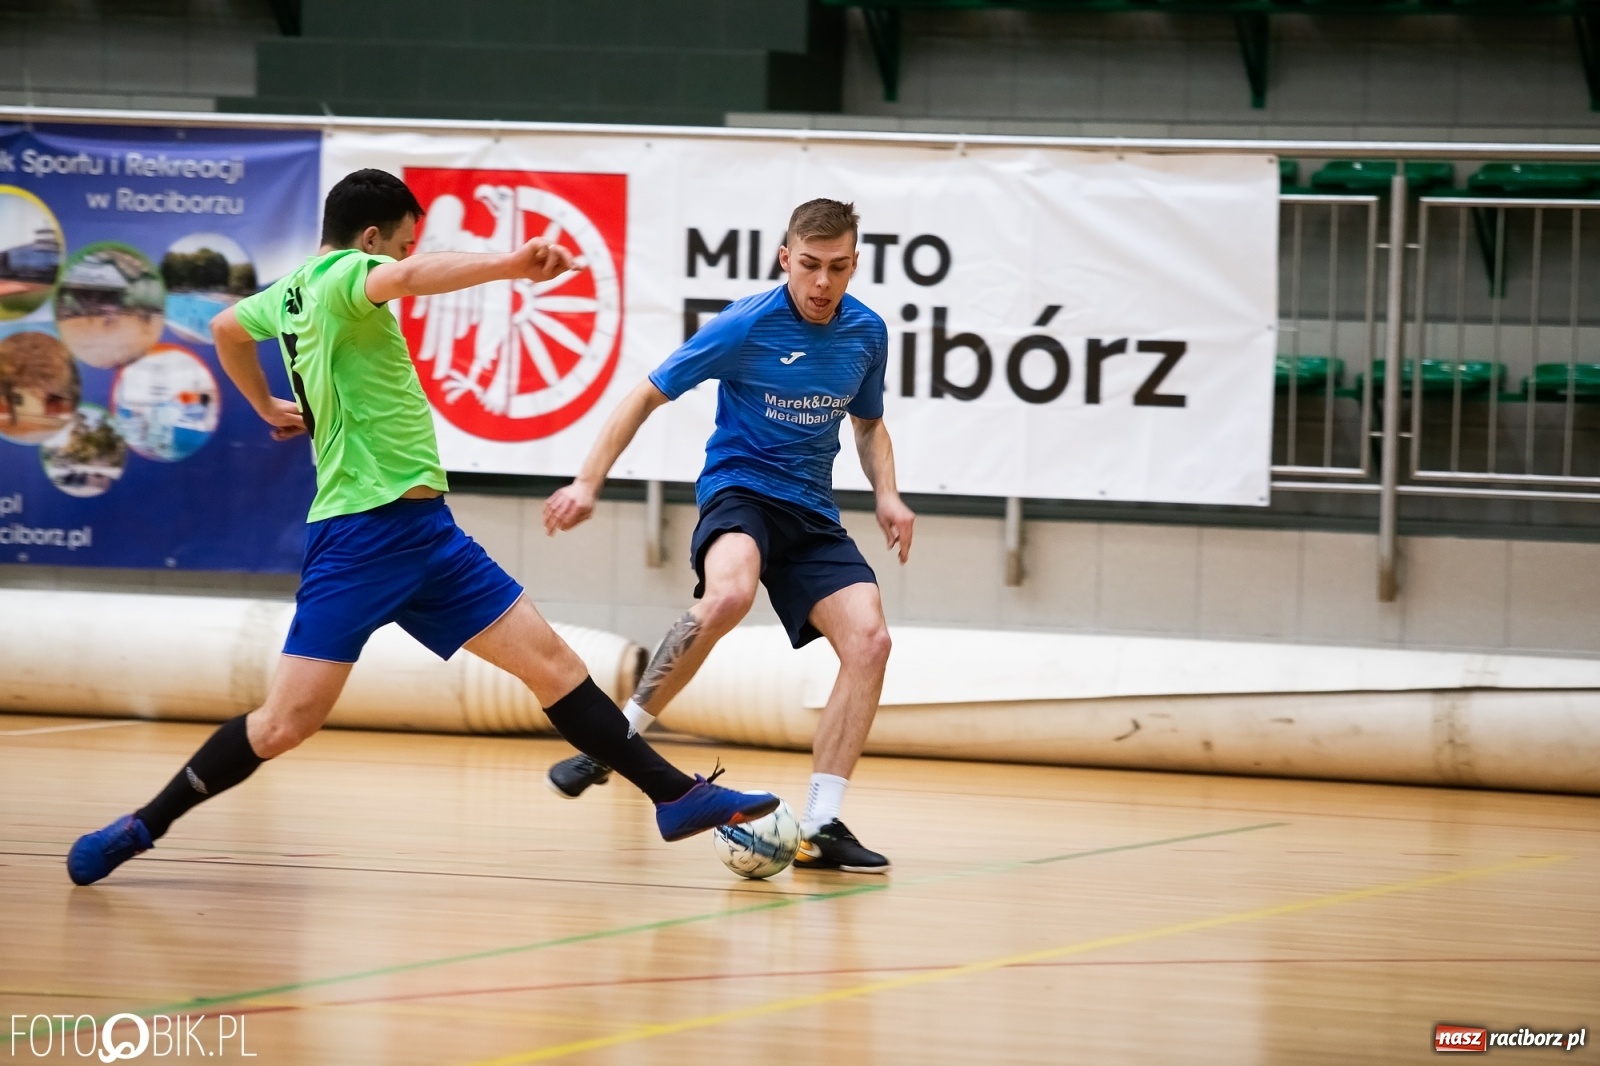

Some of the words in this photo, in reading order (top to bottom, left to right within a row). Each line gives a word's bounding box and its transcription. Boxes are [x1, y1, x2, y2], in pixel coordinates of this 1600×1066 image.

[21, 149, 104, 178] Sportu
[110, 151, 118, 175] i
[125, 152, 244, 184] Rekreacji
[85, 192, 110, 209] w
[116, 187, 244, 215] Raciborzu
[686, 227, 952, 287] MITO
[683, 298, 1189, 408] ibórz
[765, 407, 829, 425] Metallbau
[0, 524, 92, 551] ciborz.pl
